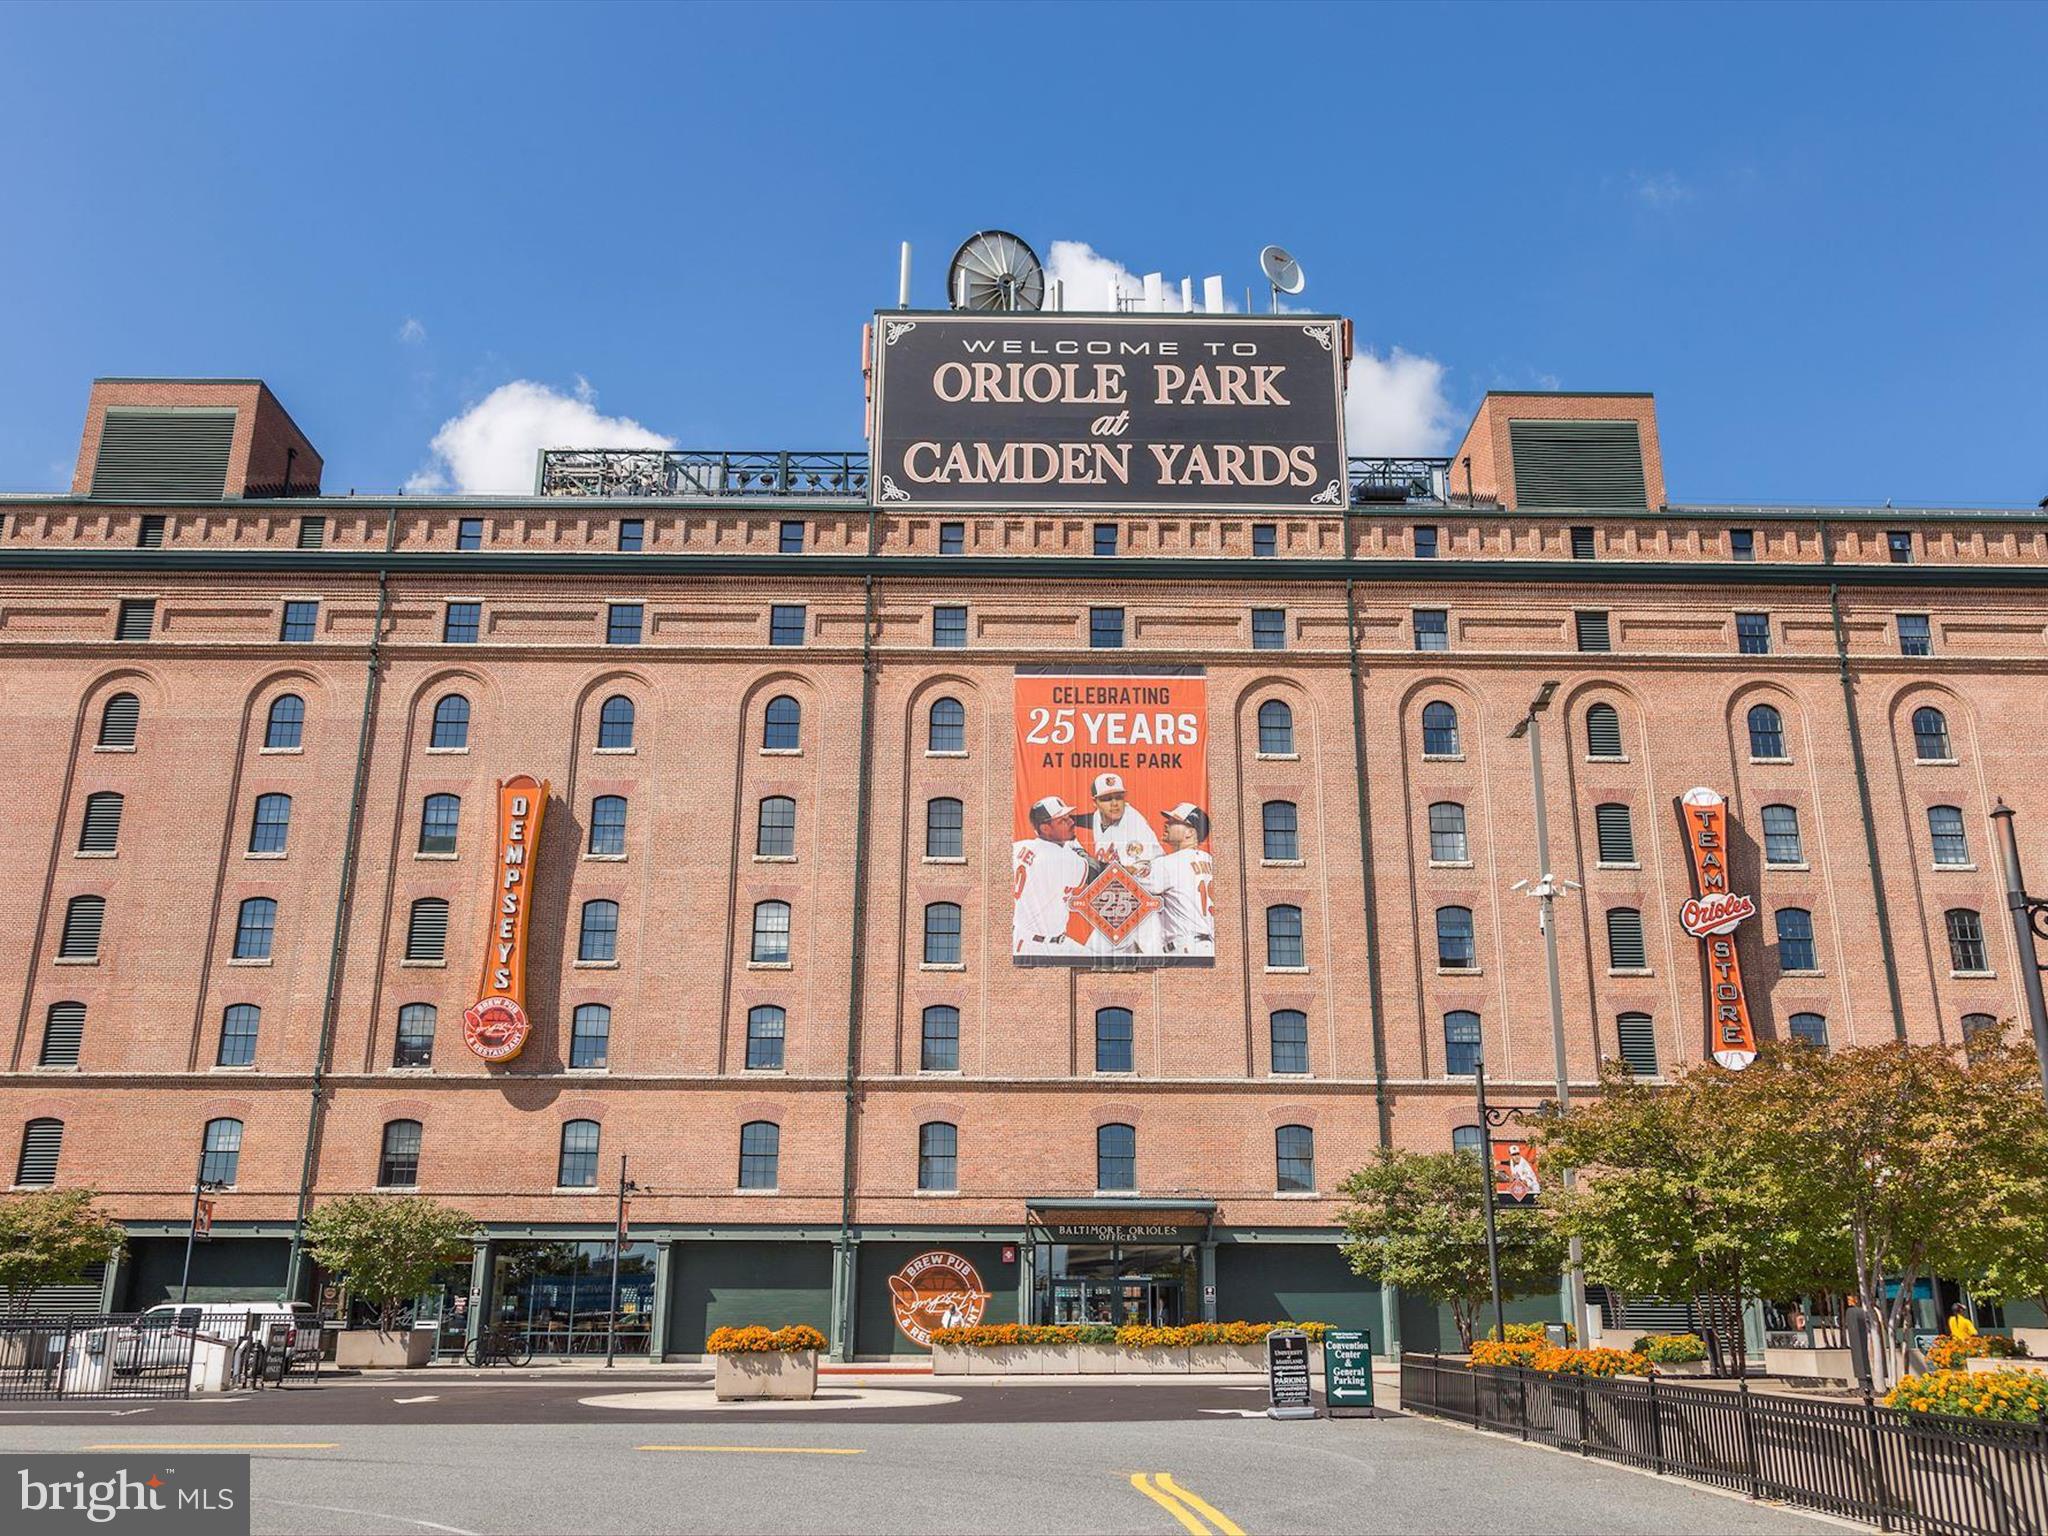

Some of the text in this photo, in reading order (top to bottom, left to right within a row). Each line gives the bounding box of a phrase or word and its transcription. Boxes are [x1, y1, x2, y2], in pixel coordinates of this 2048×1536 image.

[962, 340, 1258, 356] WELCOME TO
[932, 361, 1291, 406] ORIOLE PARK
[1090, 409, 1130, 437] at
[902, 441, 1319, 487] CAMDEN YARDS
[1053, 687, 1170, 705] CELEBRATING
[1026, 707, 1199, 745] 25 YEARS
[1042, 752, 1182, 769] AT ORIOLE PARK
[1695, 811, 1725, 889] TEAM
[493, 796, 528, 990] DEMPSEYS
[1683, 894, 1753, 931] Orioles
[1714, 940, 1745, 1044] STORE
[477, 999, 502, 1015] BREW
[1059, 1226, 1177, 1235] BALTIMORE ORIOLES
[1098, 1233, 1137, 1241] OFFICES
[906, 1255, 971, 1277] BREW PUB
[1325, 1340, 1369, 1350] Convention
[1335, 1350, 1361, 1359] Center
[1344, 1358, 1353, 1367] &
[1333, 1367, 1365, 1376] General
[1274, 1376, 1308, 1385] PARKING
[1333, 1376, 1366, 1386] Parking
